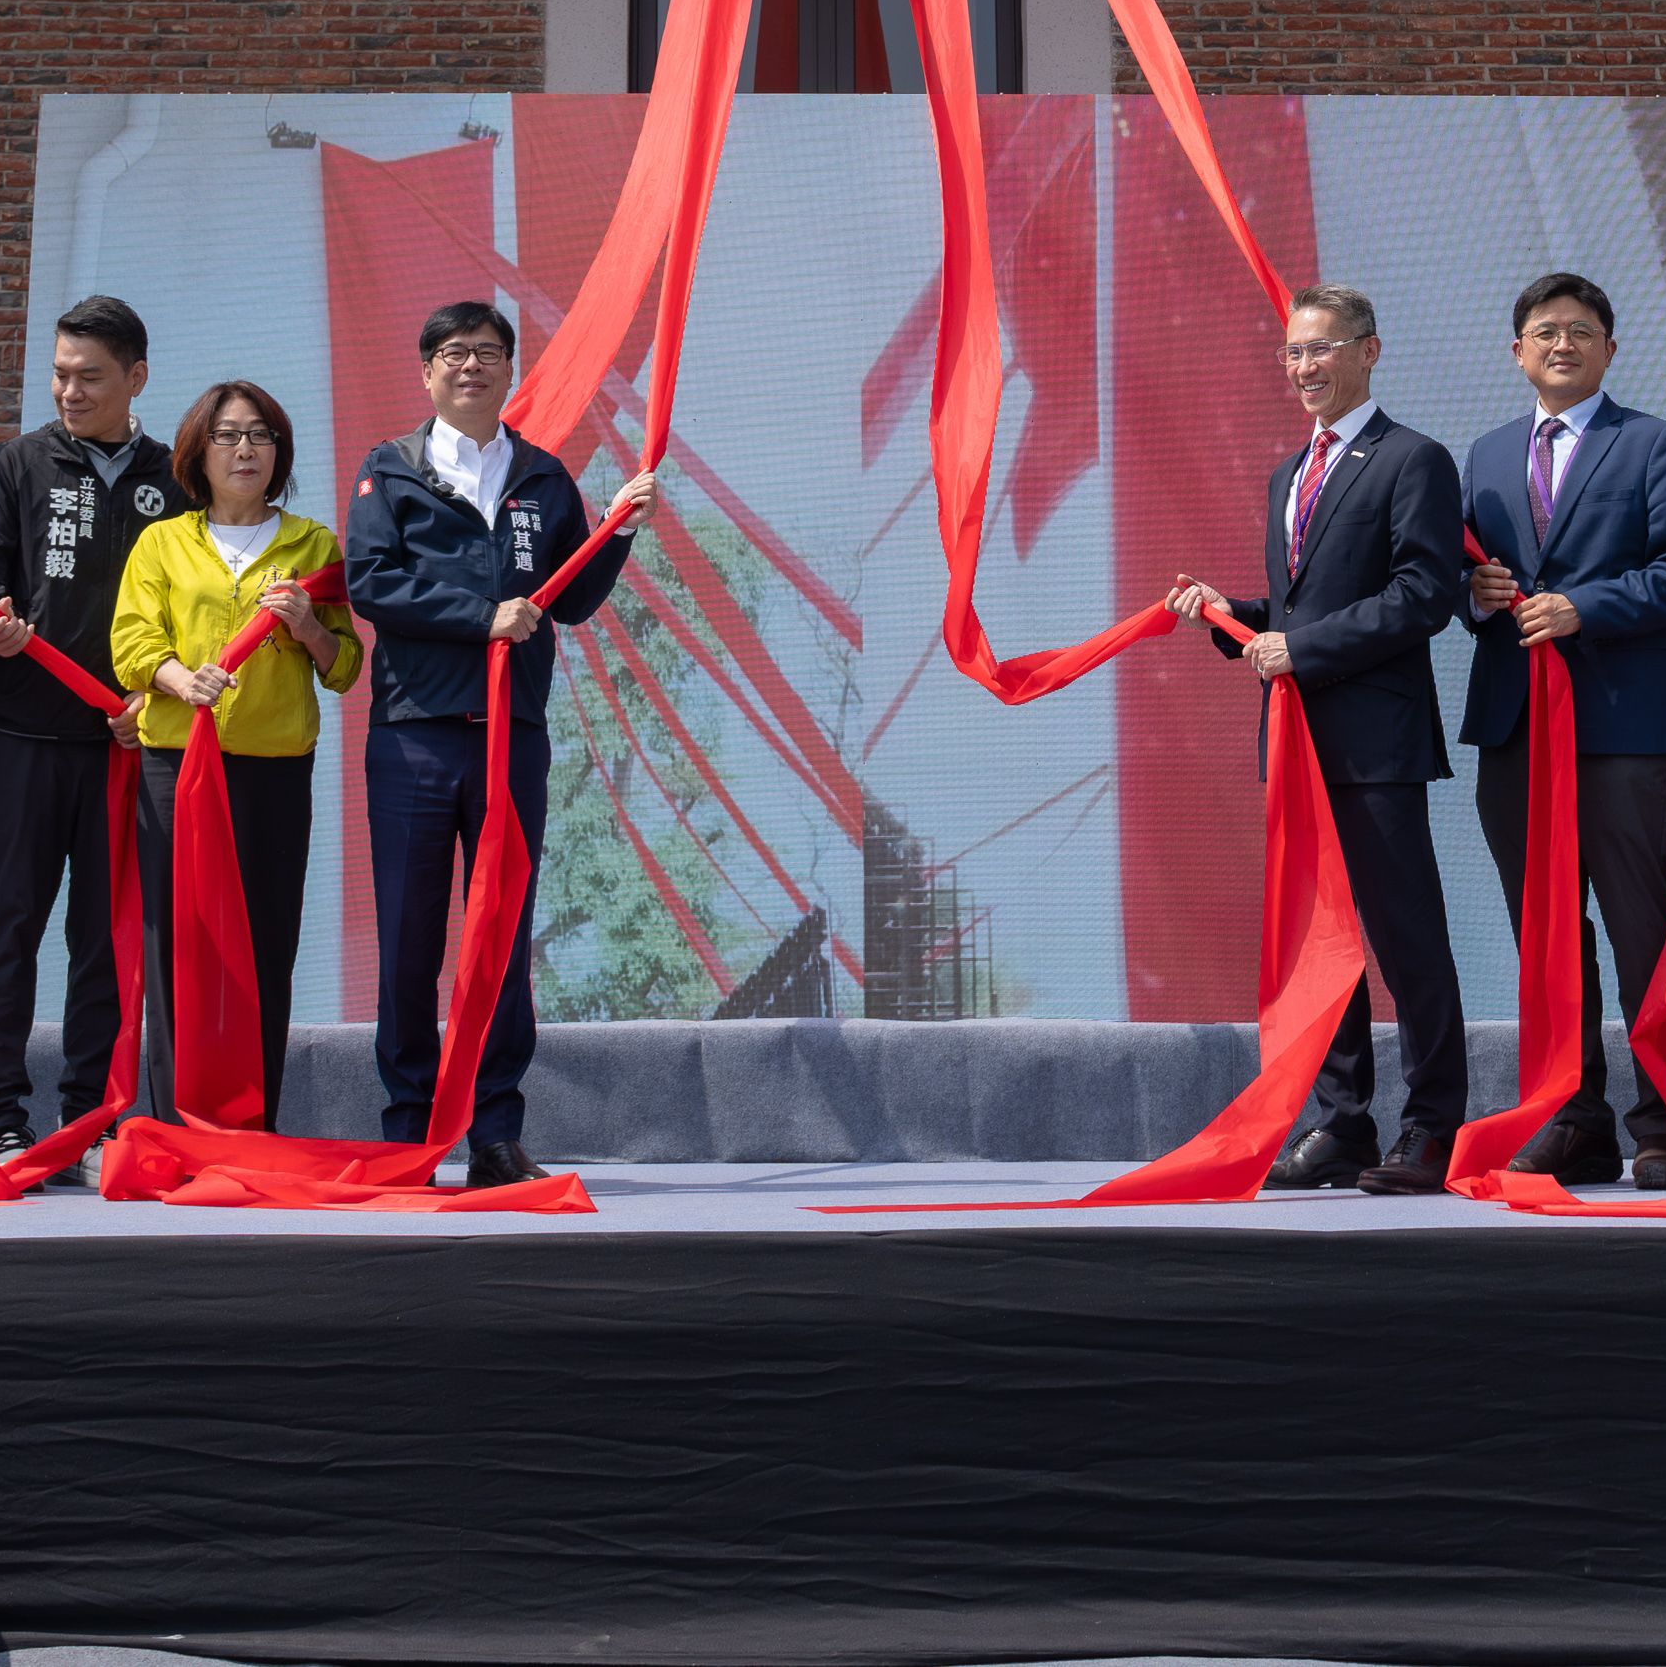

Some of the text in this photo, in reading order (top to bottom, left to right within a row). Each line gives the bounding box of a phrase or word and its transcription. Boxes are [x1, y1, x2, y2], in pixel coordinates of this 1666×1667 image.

[44, 487, 79, 580] 李柏毅
[79, 475, 96, 540] 立法委員
[510, 511, 534, 572] 陳其邁
